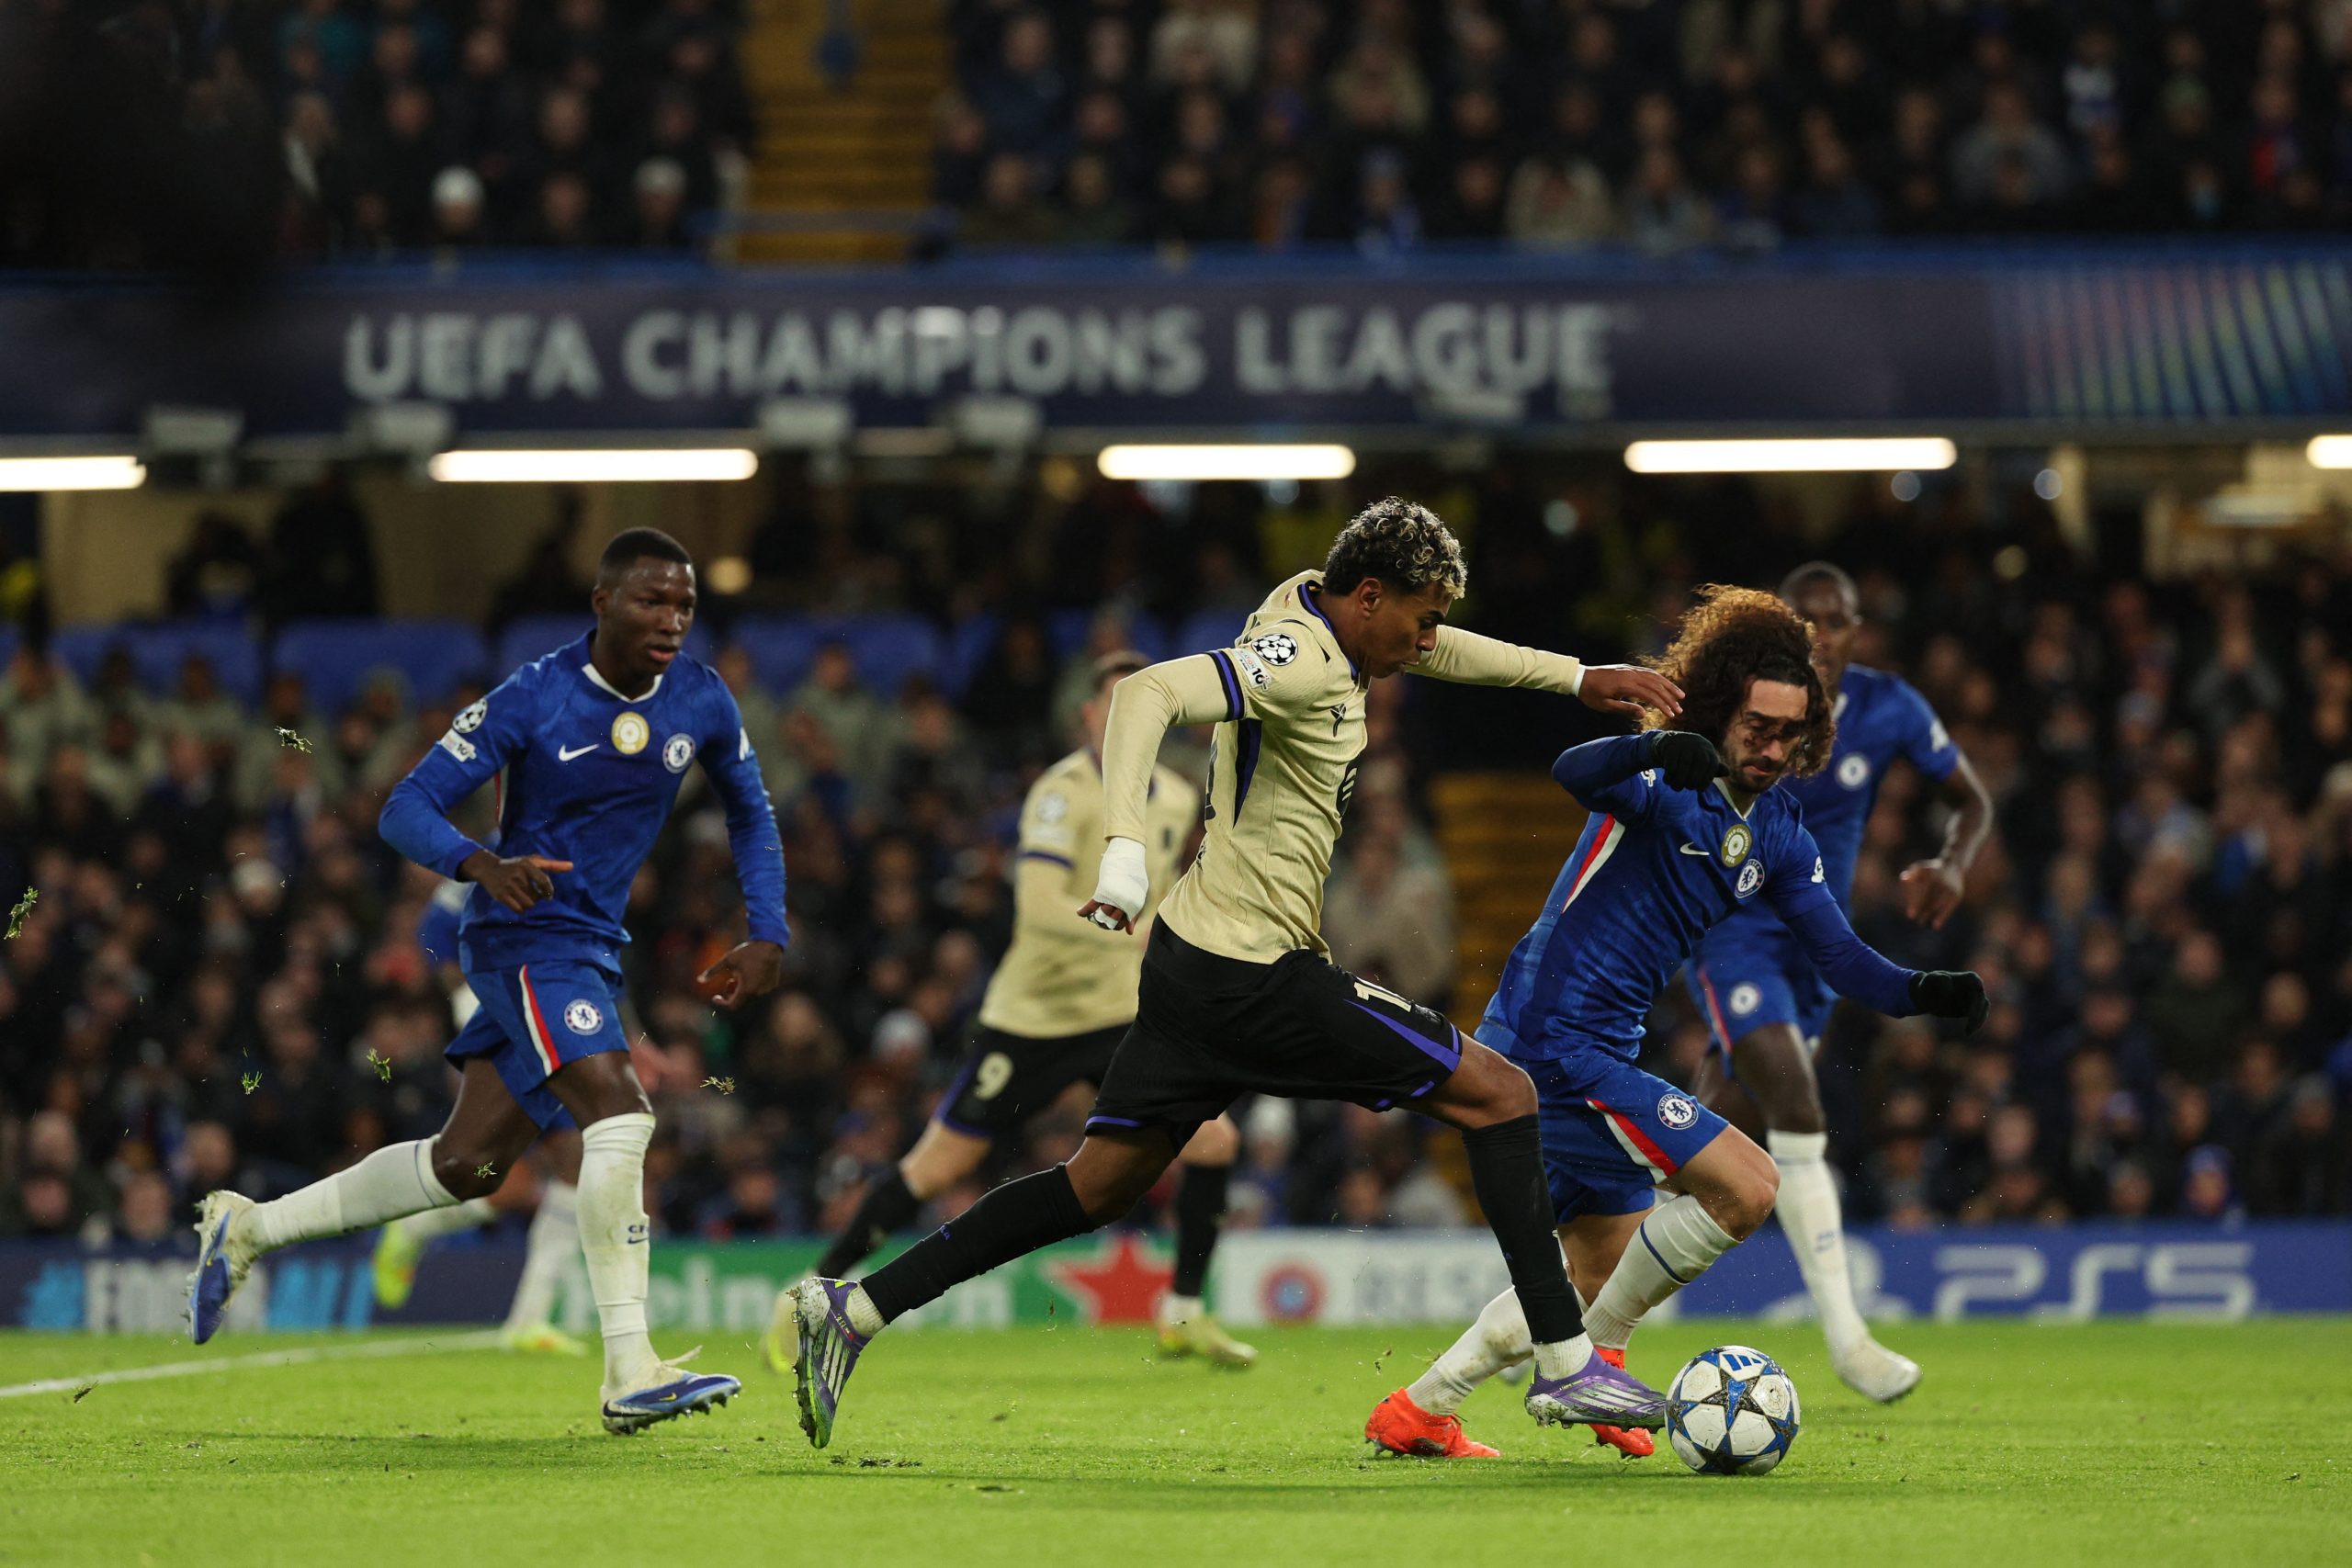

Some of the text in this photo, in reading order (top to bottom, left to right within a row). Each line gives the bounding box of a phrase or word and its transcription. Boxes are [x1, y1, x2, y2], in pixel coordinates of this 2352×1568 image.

[344, 301, 1615, 402] UEFA CHAMPIONS LEAGUE
[1353, 976, 1412, 1013] 1
[975, 1051, 1013, 1100] 9
[1932, 1242, 2256, 1325] PS5
